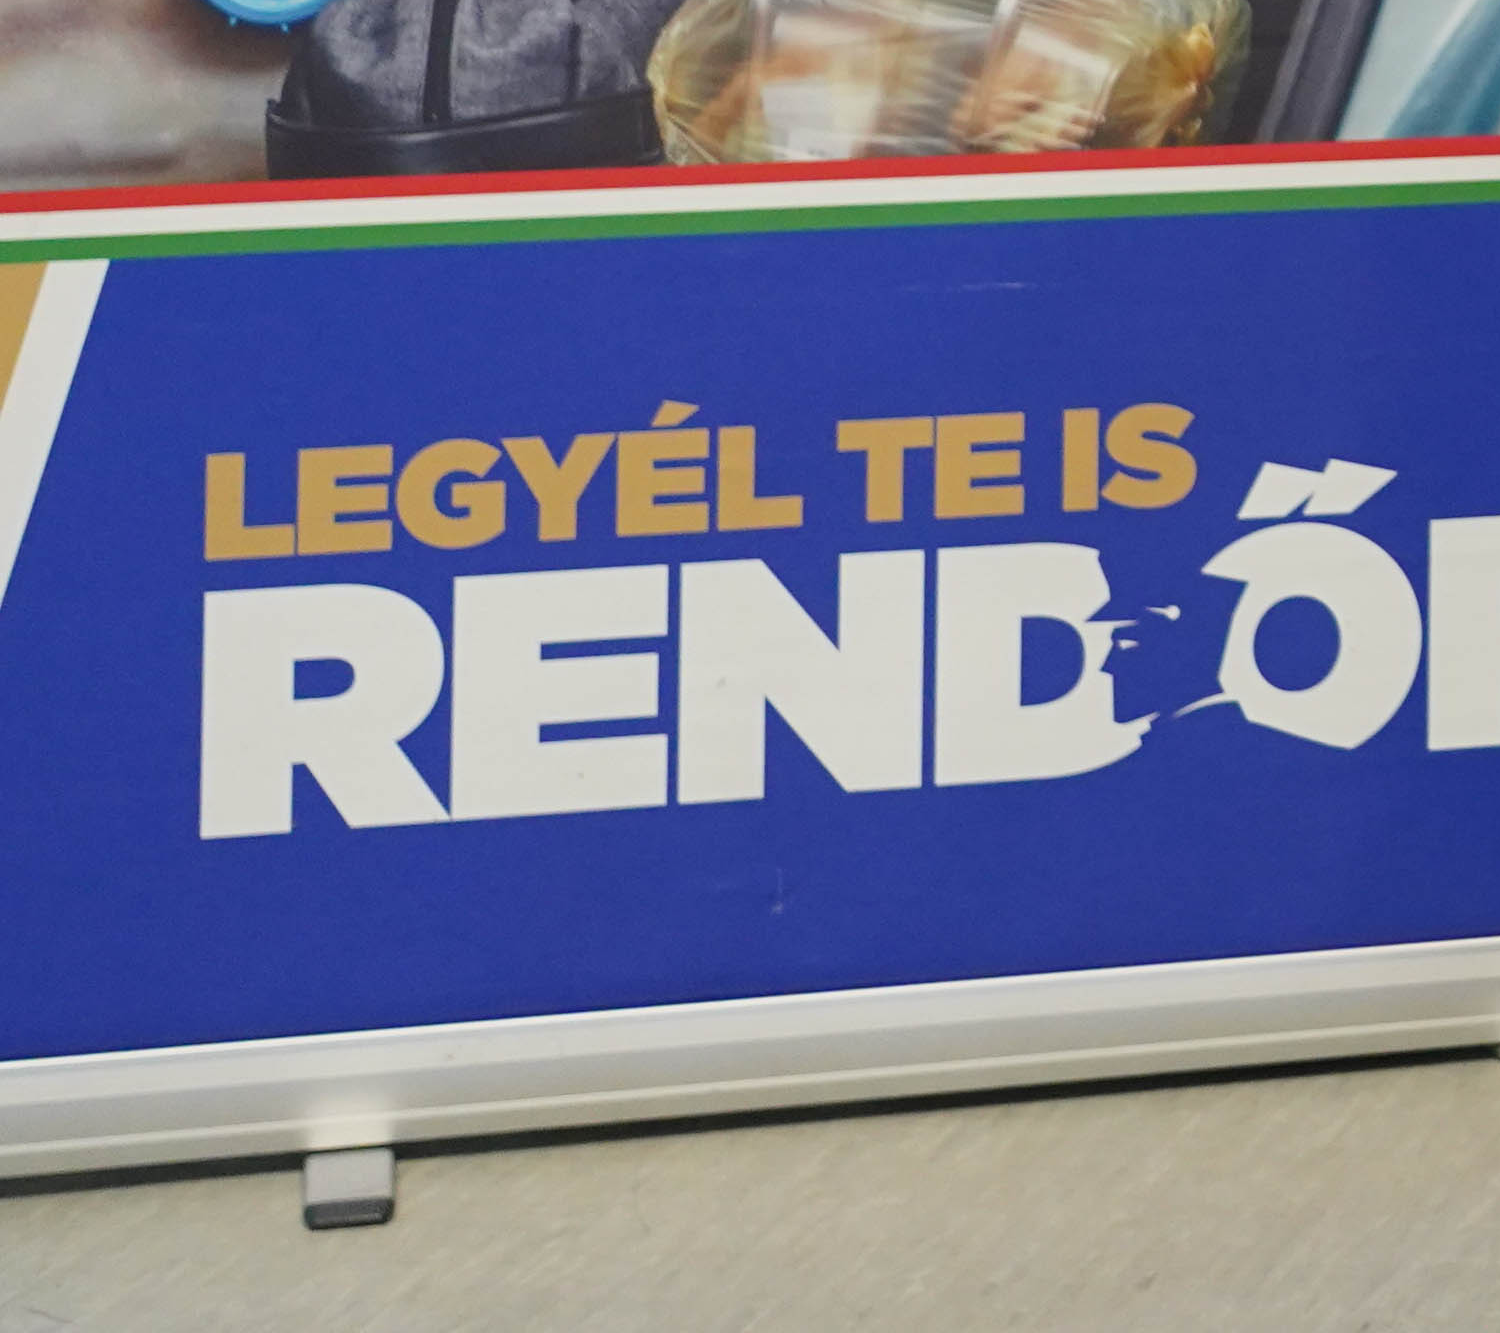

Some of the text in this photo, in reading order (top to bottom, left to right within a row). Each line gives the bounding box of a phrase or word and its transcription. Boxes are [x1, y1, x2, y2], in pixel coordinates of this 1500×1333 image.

[204, 400, 1197, 561] LEGYÉL TE IS
